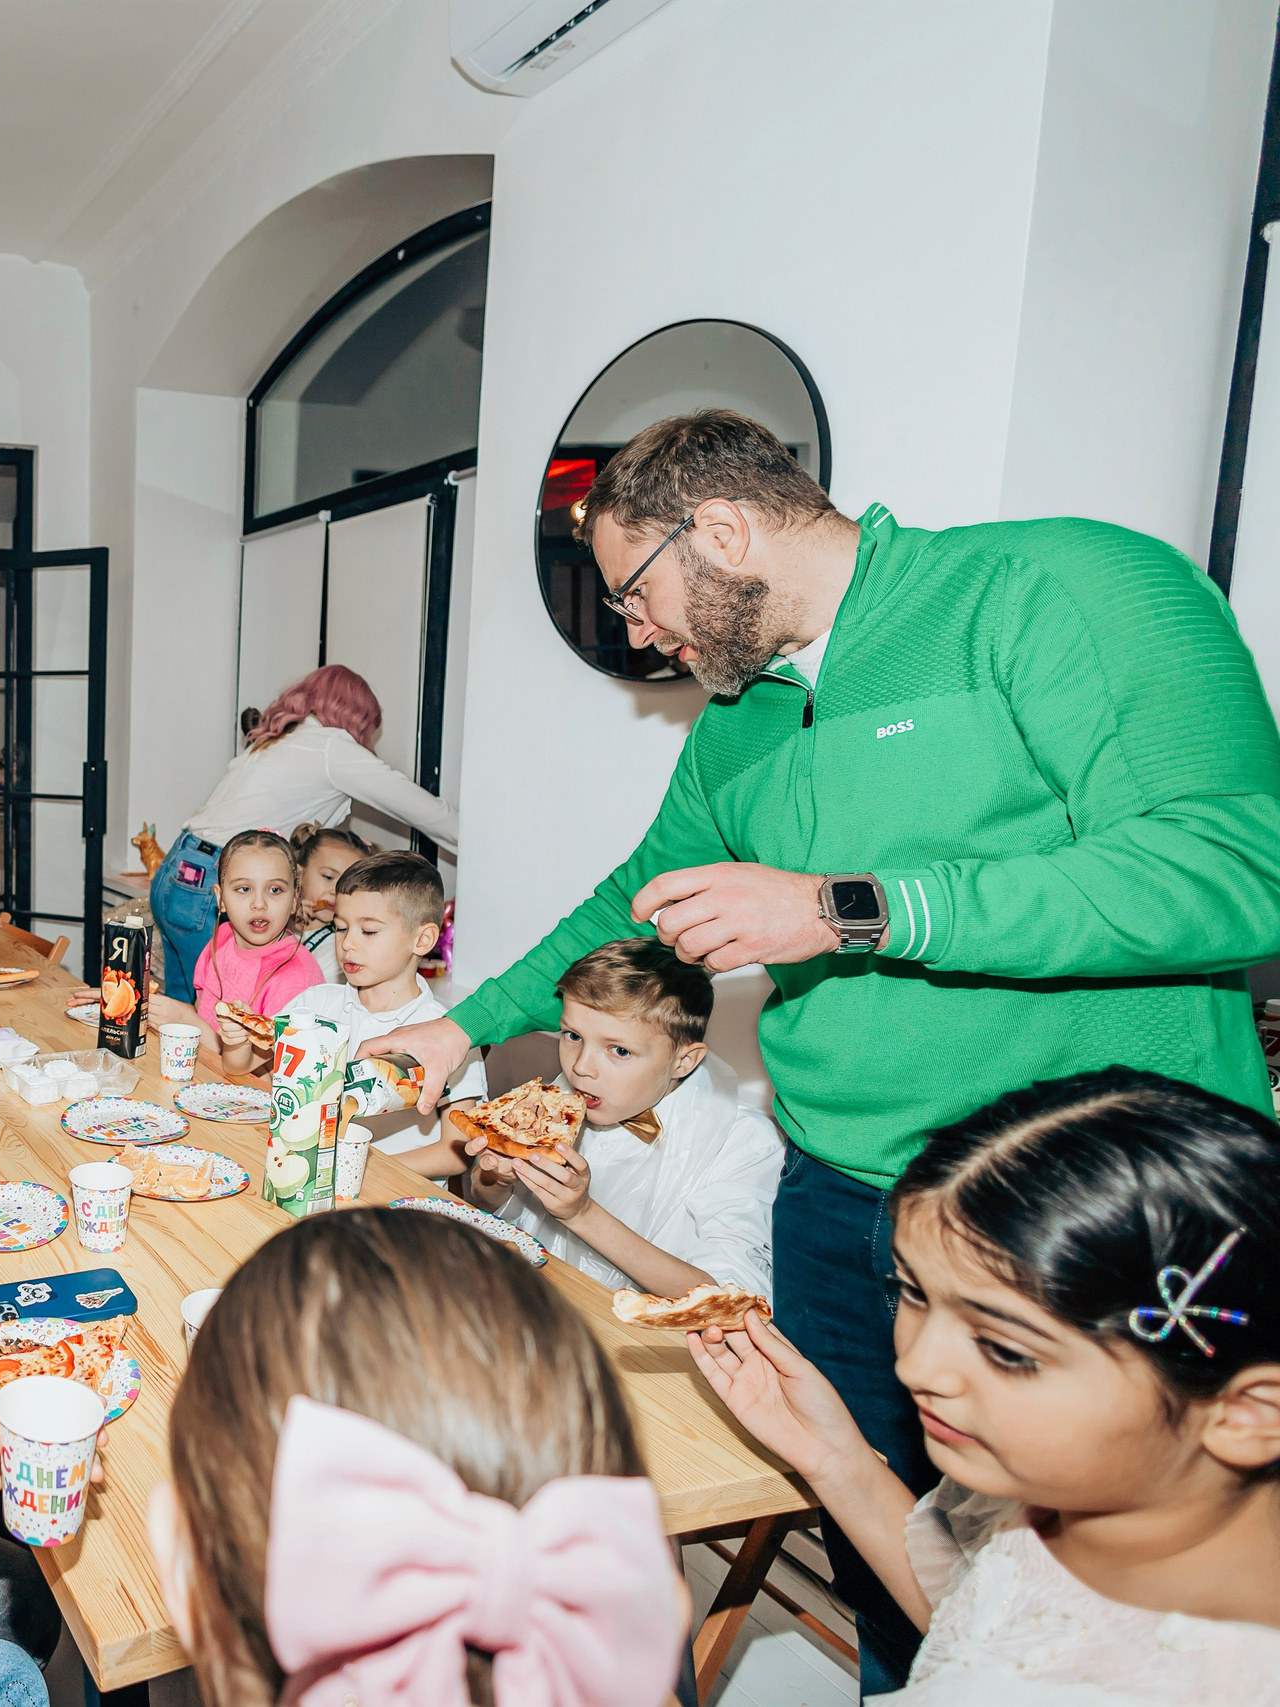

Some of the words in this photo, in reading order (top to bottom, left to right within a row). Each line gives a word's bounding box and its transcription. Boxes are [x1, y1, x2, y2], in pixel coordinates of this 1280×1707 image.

[875, 718, 915, 739] BOSS
[109, 936, 129, 963] Я
[174, 1046, 183, 1057] С
[81, 1202, 91, 1217] С
[2, 1446, 12, 1473] С
[16, 1460, 86, 1489] ДНЁМ
